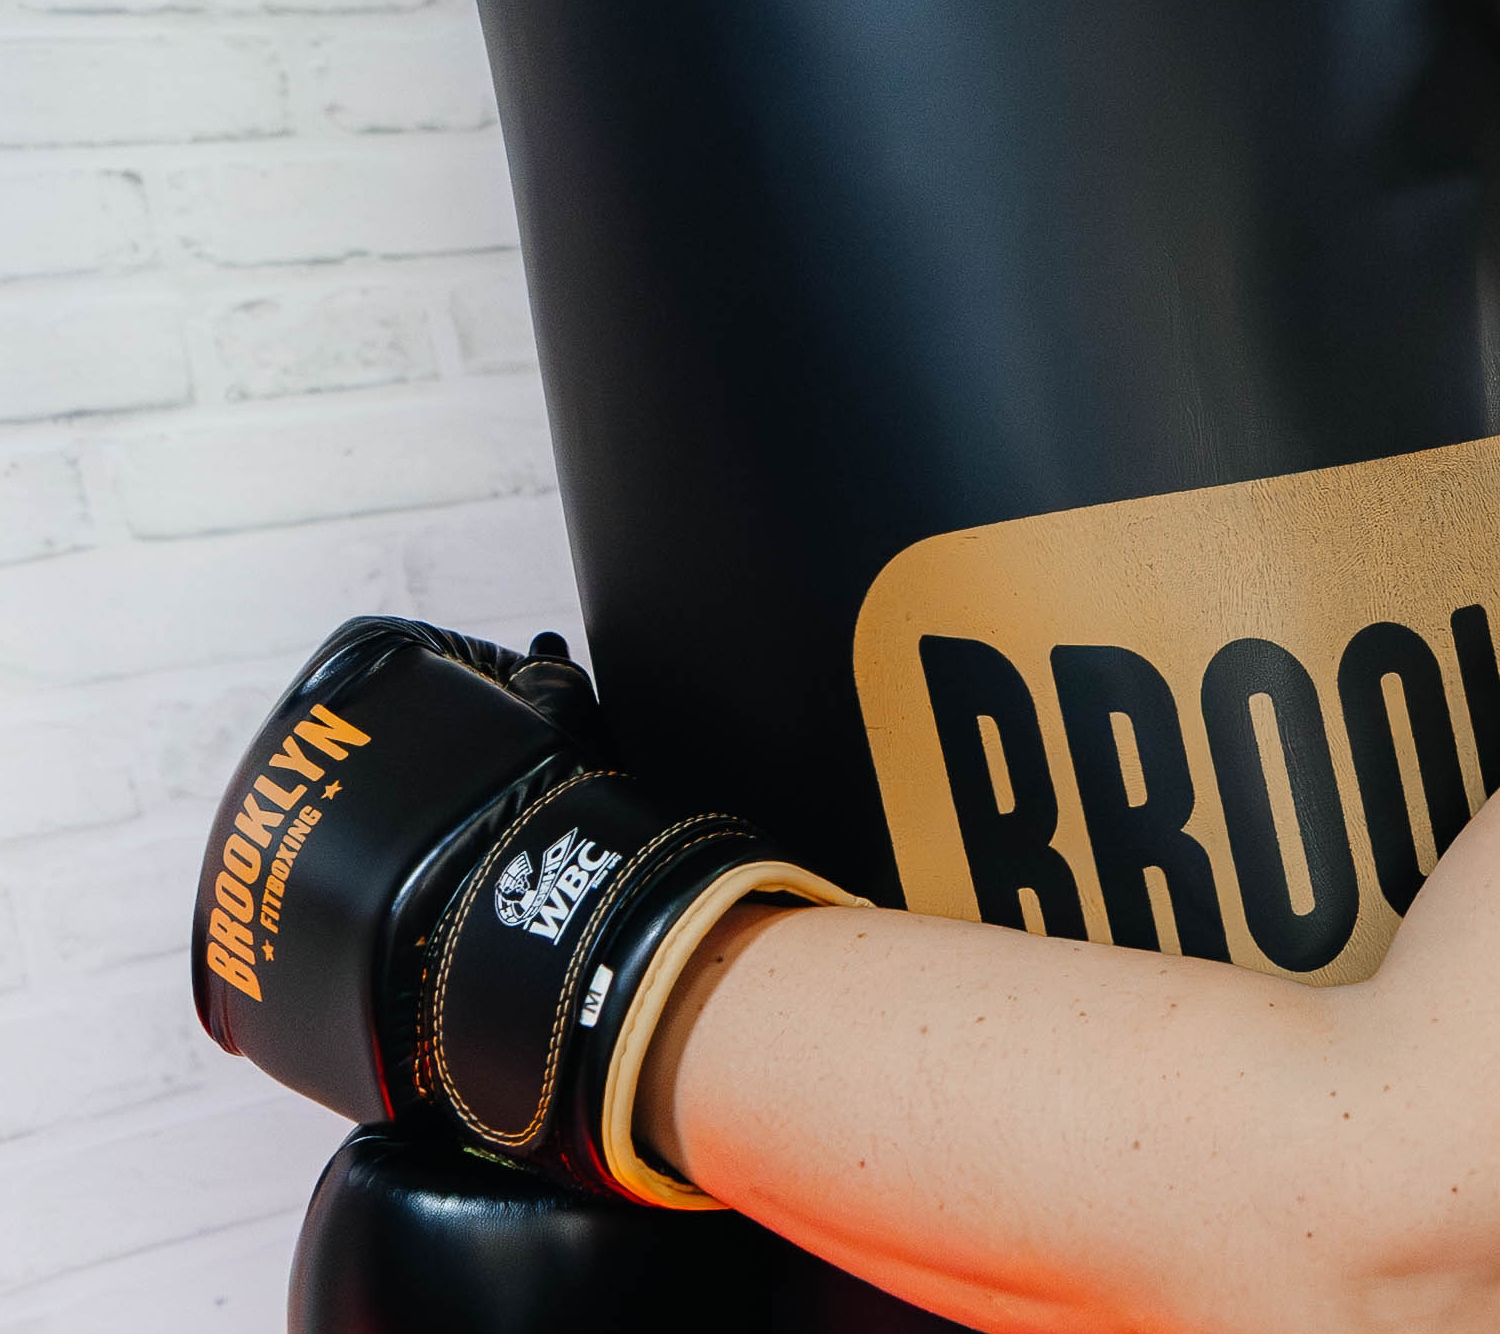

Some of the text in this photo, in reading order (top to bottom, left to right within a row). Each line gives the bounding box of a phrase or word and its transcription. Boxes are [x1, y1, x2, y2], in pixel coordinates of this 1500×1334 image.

[206, 703, 372, 1003] BROOKLYN
[260, 804, 323, 935] FITBOXING
[528, 841, 610, 940] WBC
[582, 987, 603, 1014] M
